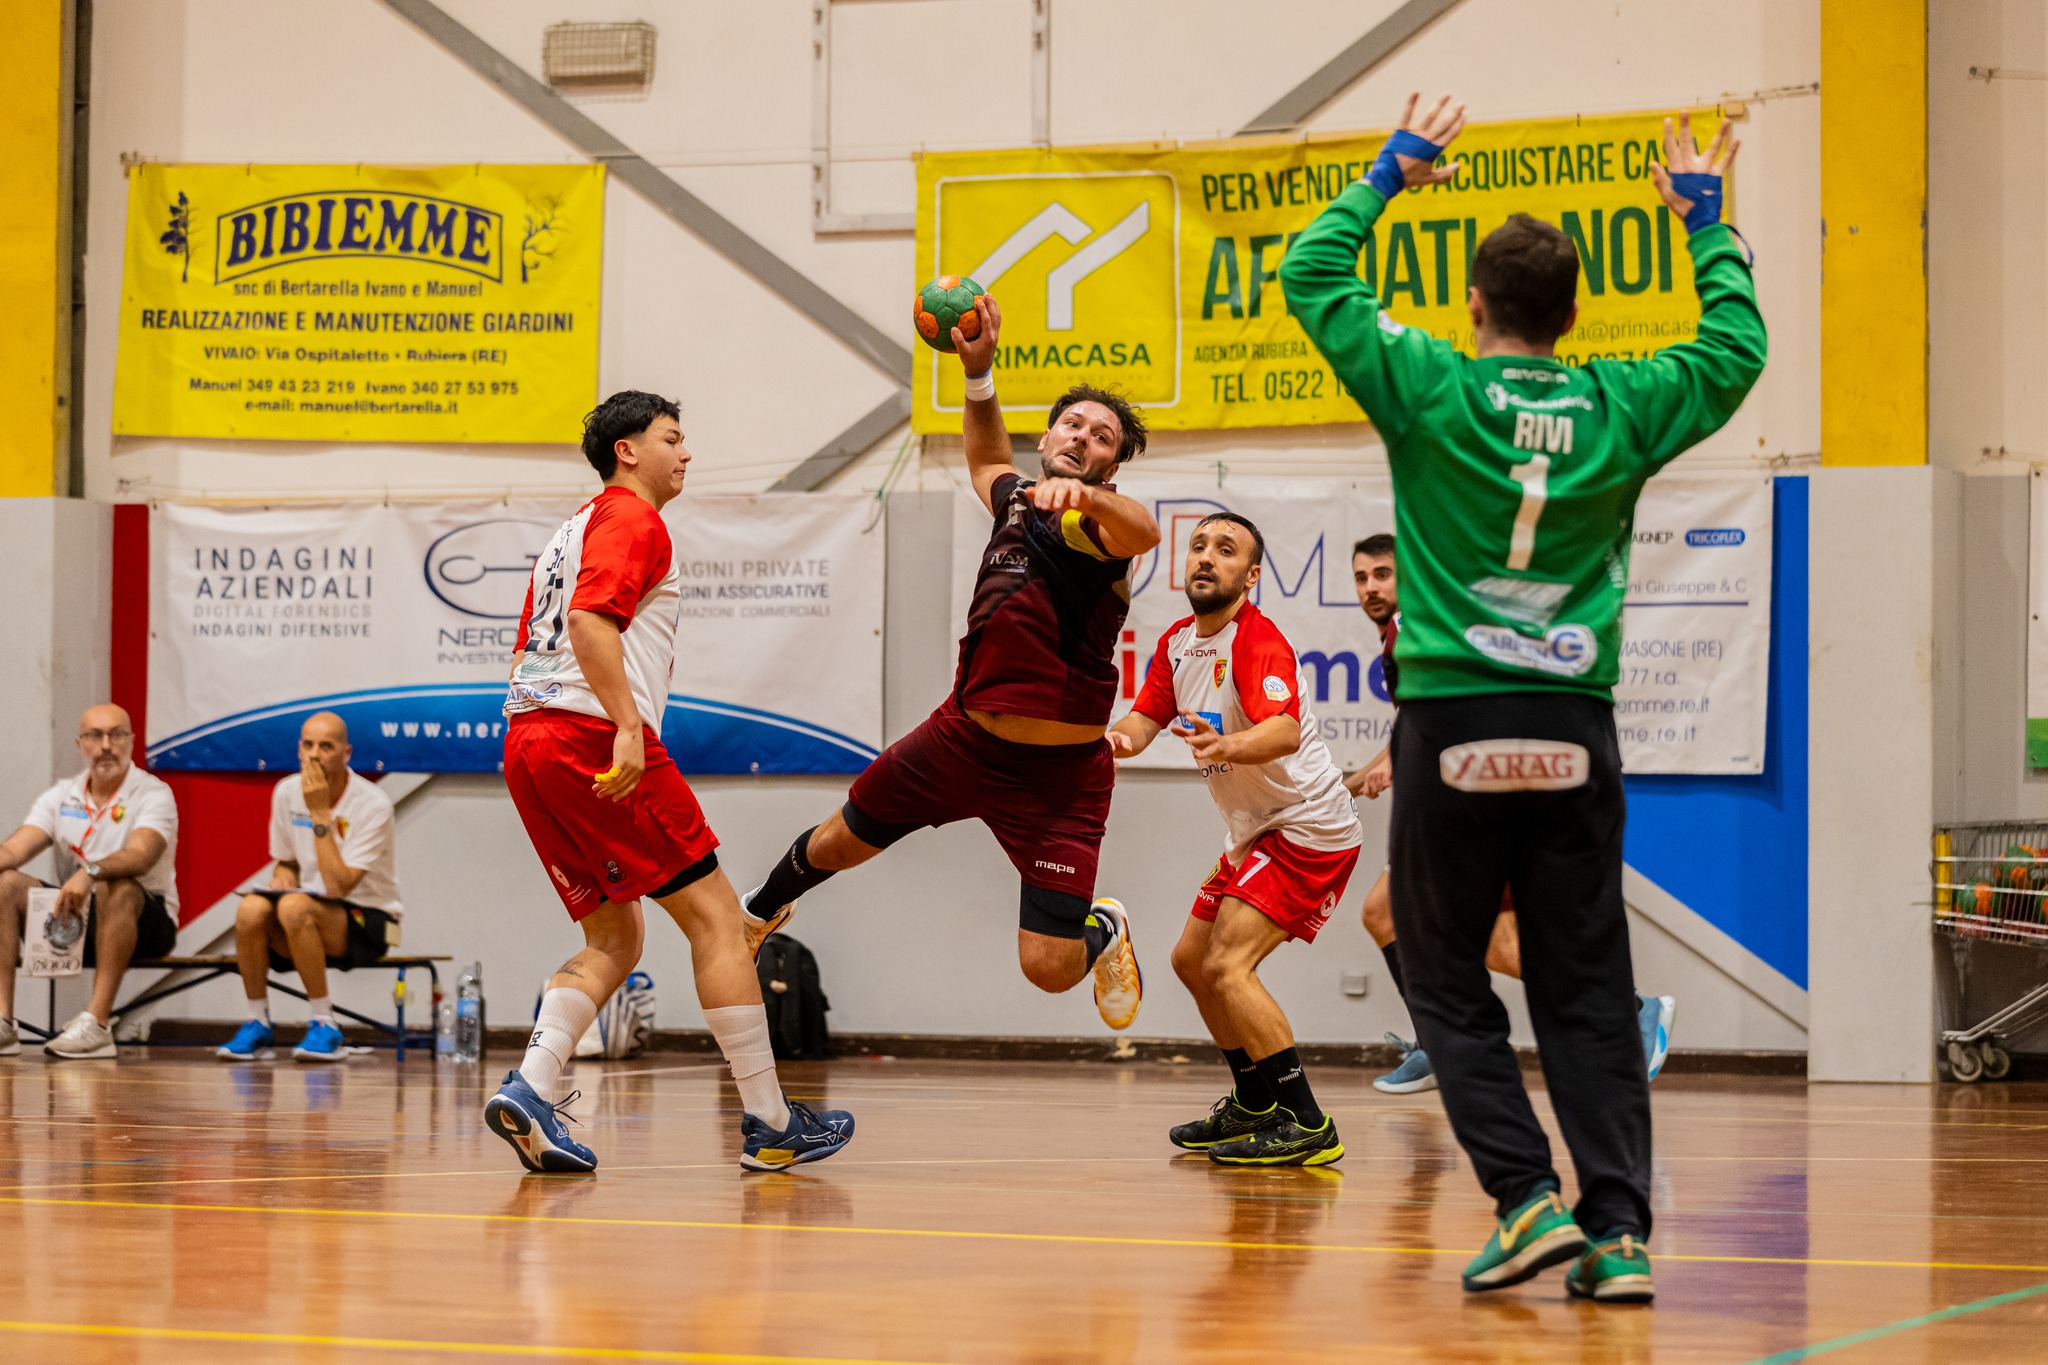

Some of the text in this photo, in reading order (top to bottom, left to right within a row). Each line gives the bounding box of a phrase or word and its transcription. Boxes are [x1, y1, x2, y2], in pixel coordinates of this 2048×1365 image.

[1201, 173, 1259, 212] PER
[1265, 160, 1373, 208] VENDE
[1433, 142, 1615, 193] ACQUISTARE
[225, 197, 493, 268] BIBIEMME
[1561, 205, 1673, 297] NOI
[234, 280, 482, 297] snc di Bertarella Ivano e Manuel
[141, 309, 573, 333] REALIZZAZIONE E MANUTENZIONE GIARDINI
[204, 346, 508, 366] VIVAIO: Via Ospitaletto Rubiera (RE)
[993, 343, 1152, 369] RIMACASA
[1194, 341, 1308, 363] AGENZIA RUBIERA
[190, 378, 519, 395] Manuel 349 43 23 219 Ivano 340 27 53 975
[1211, 373, 1256, 403] TEL.
[1265, 370, 1324, 401] 0522
[245, 399, 458, 414] e-mail: manuel@bertarella.it
[1513, 410, 1574, 454] RIVI
[1506, 454, 1551, 571] 1
[1687, 531, 1742, 545] TRICOFLEX
[195, 547, 373, 571] INDAGINI
[680, 559, 830, 578] AGINI PRIVATE
[197, 576, 372, 599] AZIENDALI
[717, 584, 829, 599] ASSICURATIVE
[1645, 578, 1717, 596] Giuseppe
[1720, 577, 1731, 594] &
[194, 604, 372, 619] DIGITAL FORENSICS
[741, 605, 831, 619] COMMERCIALI
[193, 623, 371, 638] INDAGINI DIFENSIVE
[1183, 649, 1217, 658] GIVOVA
[1691, 639, 1723, 661] (RE)
[1616, 695, 1710, 714] emme.re.it
[381, 721, 503, 738] www.ner
[1618, 724, 1697, 743] me.re.it
[1201, 762, 1229, 779] onic
[1477, 753, 1573, 780] ARAG
[1035, 860, 1076, 875] maps
[1236, 850, 1272, 887] 7
